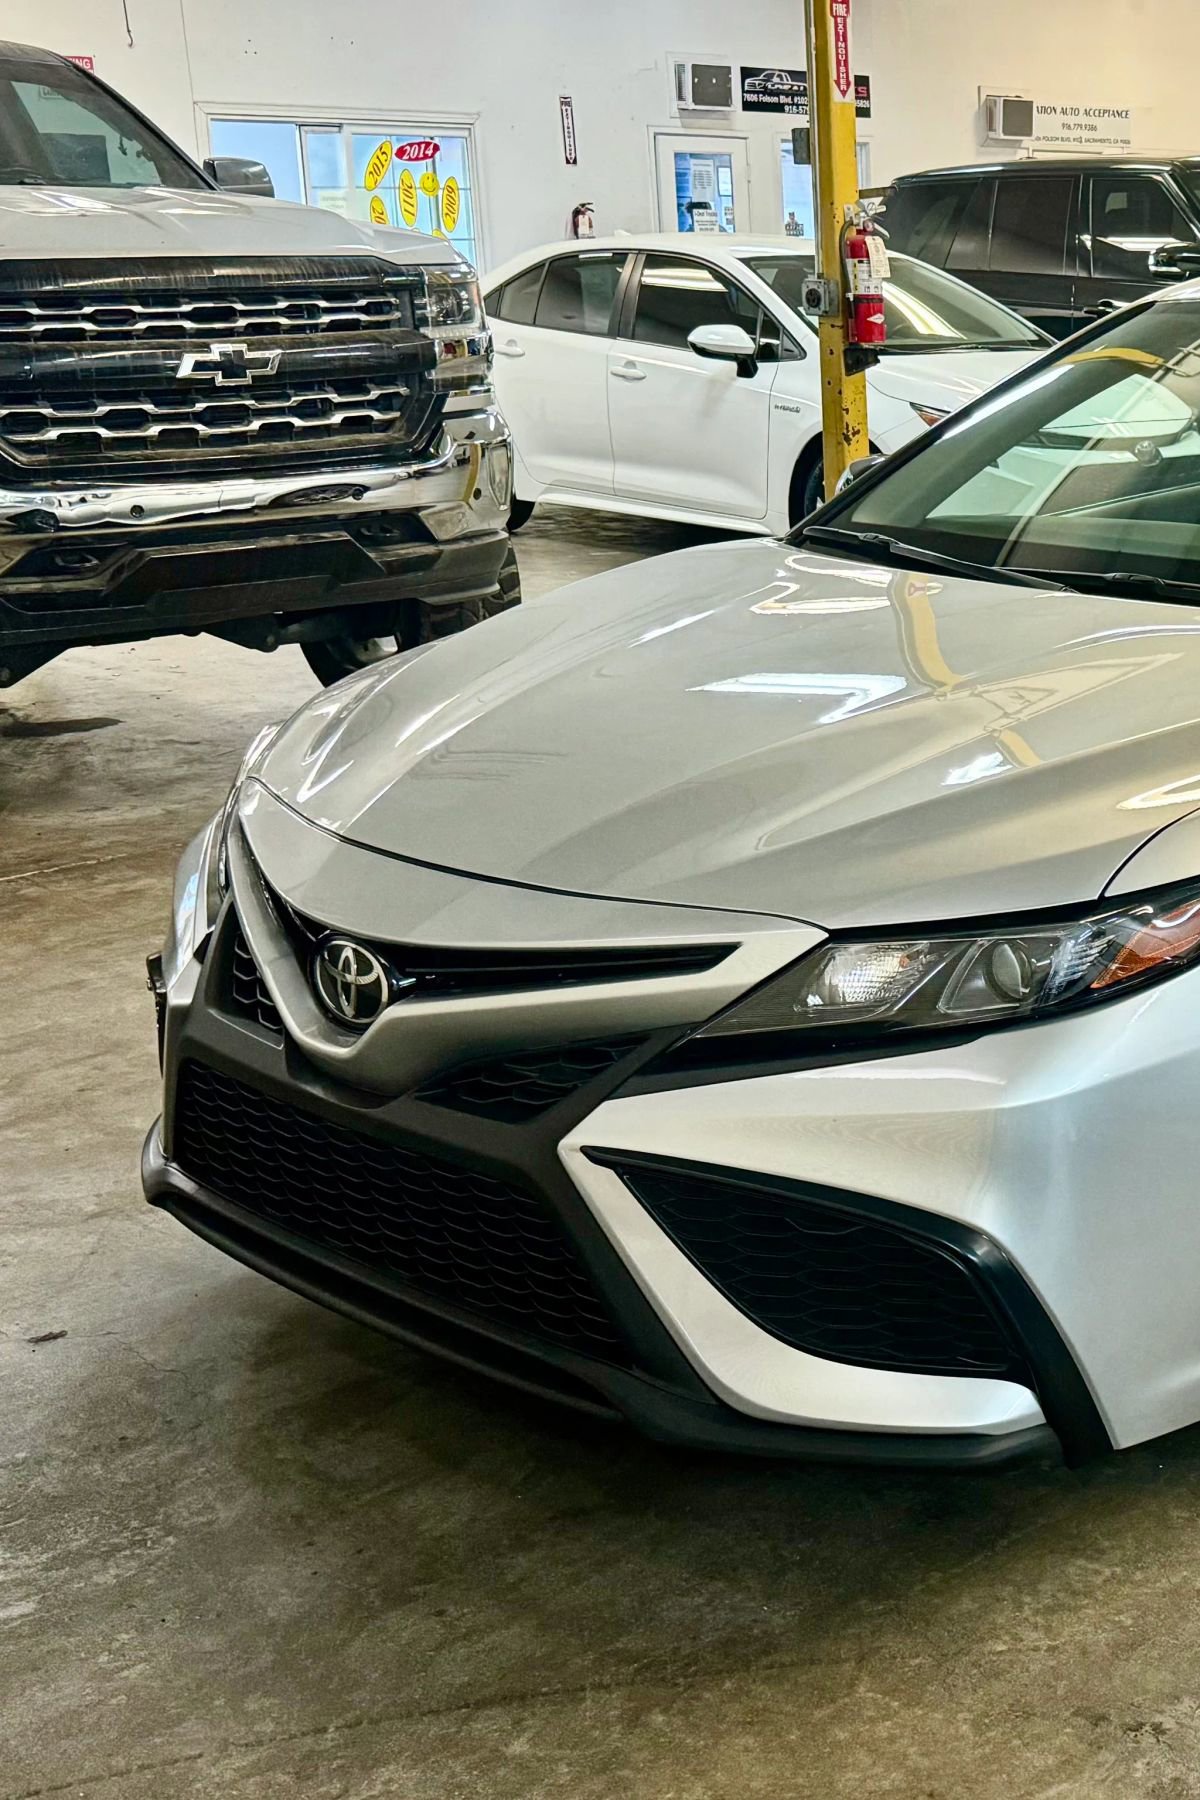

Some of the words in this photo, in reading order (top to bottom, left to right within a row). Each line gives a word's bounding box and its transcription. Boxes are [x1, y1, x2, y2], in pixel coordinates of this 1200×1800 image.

[833, 3, 847, 16] FIRE
[837, 17, 847, 91] EXTINGUISHER
[1060, 107, 1080, 116] AUTO
[1083, 109, 1130, 119] ACCEPTANCE
[368, 146, 389, 186] 2015
[402, 142, 434, 160] 2014
[401, 178, 415, 217] 2011
[444, 184, 457, 224] 2009
